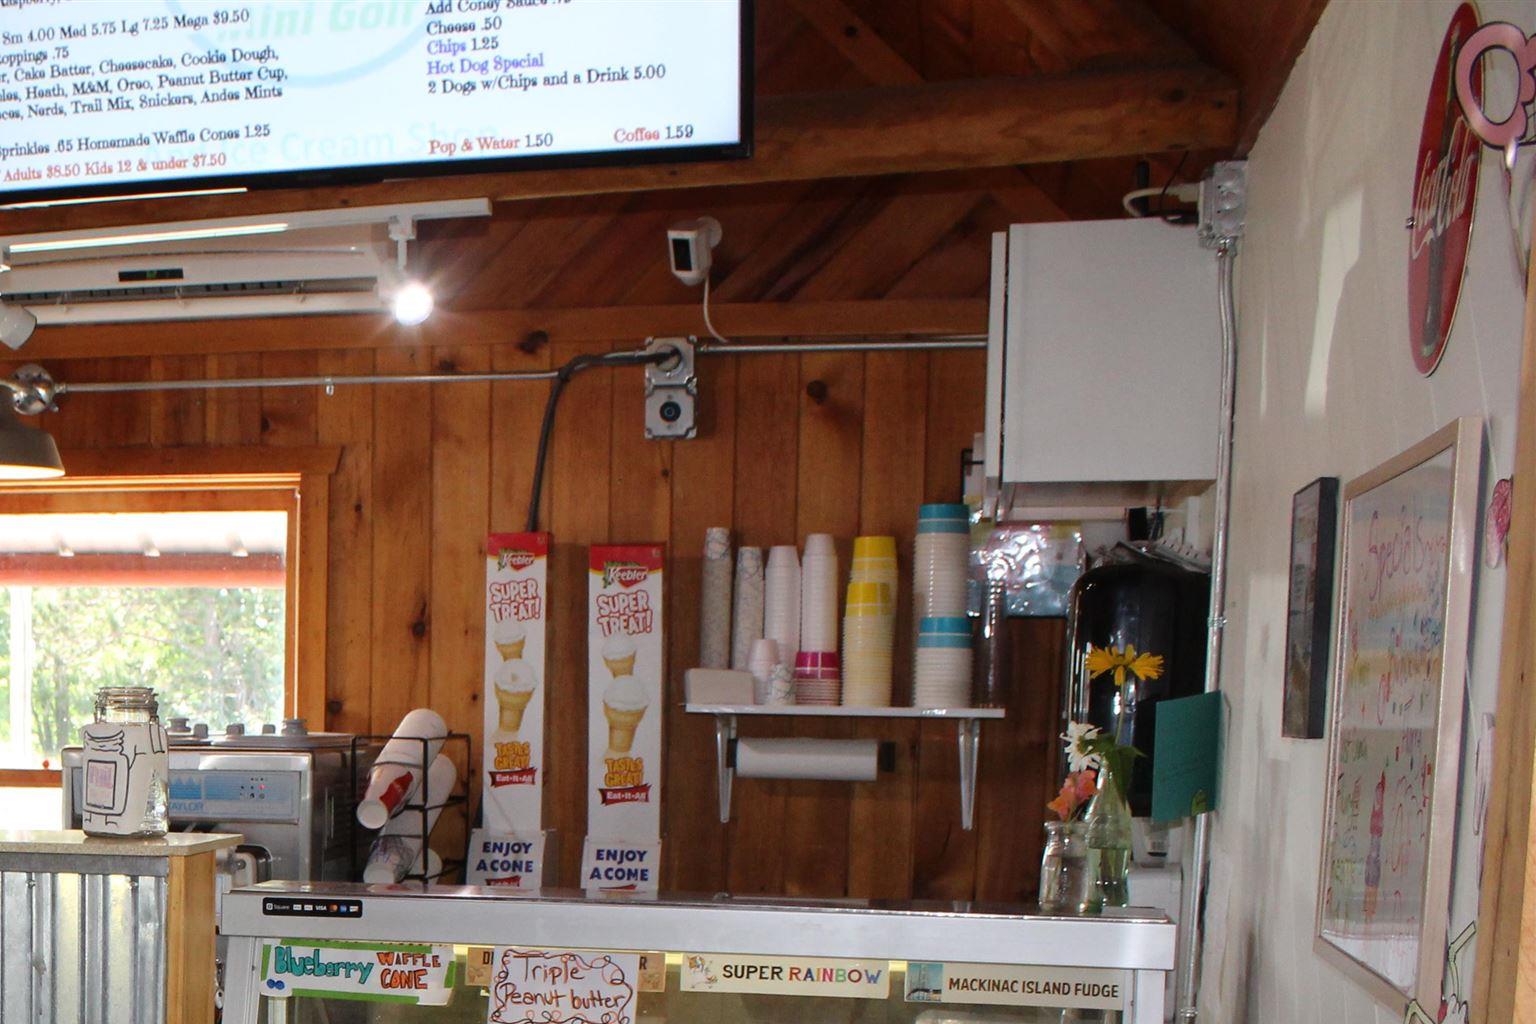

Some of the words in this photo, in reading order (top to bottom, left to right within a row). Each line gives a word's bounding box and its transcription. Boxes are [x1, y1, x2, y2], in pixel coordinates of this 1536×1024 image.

[426, 0, 453, 15] Add
[2, 31, 23, 46] Sm
[27, 27, 55, 43] 4.00
[60, 25, 86, 39] Med
[91, 21, 116, 36] 5.75
[121, 19, 139, 36] Lg
[142, 15, 168, 32] 7.25
[173, 13, 208, 31] Mega
[213, 8, 250, 25] $9.50
[427, 19, 476, 36] Cheese
[481, 16, 502, 31] .50
[52, 46, 70, 60] .75
[427, 39, 466, 56] Chips
[471, 36, 499, 51] 1.25
[14, 66, 46, 83] Cake
[50, 63, 95, 80] Batter,
[99, 55, 177, 76] Cheesecake,
[181, 50, 227, 68] Cookie
[231, 44, 279, 64] Dough,
[427, 61, 455, 76] Hot
[460, 58, 489, 75] Dog
[493, 53, 545, 72] Special
[26, 84, 68, 100] Heath,
[72, 79, 113, 96] M&M,
[117, 76, 154, 93] Oreo,
[158, 73, 205, 89] Peanut
[209, 69, 253, 85] Butter
[257, 65, 288, 83] Cup,
[428, 81, 436, 95] 2
[442, 78, 477, 96] Dogs
[481, 74, 538, 92] w/Chips
[543, 70, 568, 87] and
[573, 73, 581, 84] a
[587, 66, 629, 84] Drink
[633, 64, 666, 81] 5.00
[27, 102, 67, 119] Nerds,
[70, 98, 102, 114] Trail
[107, 96, 135, 112] Mix,
[139, 91, 198, 109] Snickers,
[201, 88, 240, 104] Andes
[245, 85, 283, 100] Mints
[77, 134, 150, 152] Homemade
[153, 128, 196, 145] Waffle
[200, 127, 240, 142] Cones
[244, 124, 271, 139] 1.25
[428, 138, 457, 156] Pop
[461, 137, 473, 152] &
[476, 135, 521, 151] Water
[525, 133, 554, 149] 1.50
[614, 127, 660, 144] Coffee
[664, 124, 694, 140] 1.59
[4, 166, 43, 183] Adults
[46, 163, 81, 179] $8.50
[84, 160, 113, 176] Kids
[118, 158, 132, 174] 12
[136, 157, 148, 172] &
[152, 155, 188, 171] under
[192, 152, 227, 169] $7.50
[501, 552, 535, 568] Keebler
[607, 566, 648, 584] Keebler
[489, 578, 538, 602] SUPER
[489, 598, 541, 623] TREAT!
[596, 589, 649, 616] SUPER
[597, 610, 653, 637] TREAT!
[605, 757, 644, 773] TASTES
[483, 842, 533, 857] ENJOY
[596, 849, 647, 865] ENJOY
[476, 860, 488, 872] A
[490, 860, 534, 873] CONE
[590, 868, 602, 880] A
[275, 946, 374, 984] Blueberry
[377, 952, 441, 968] WAFFLE
[512, 953, 585, 985] Triple
[380, 968, 428, 989] CONE
[723, 964, 783, 981] SUPER
[788, 966, 882, 984] RAINBOW
[499, 983, 565, 1008] Peanut
[570, 989, 626, 1008] butter
[948, 977, 1019, 993] MACKINAC
[1022, 980, 1071, 996] ISLAND
[1074, 982, 1119, 998] FUDGE
